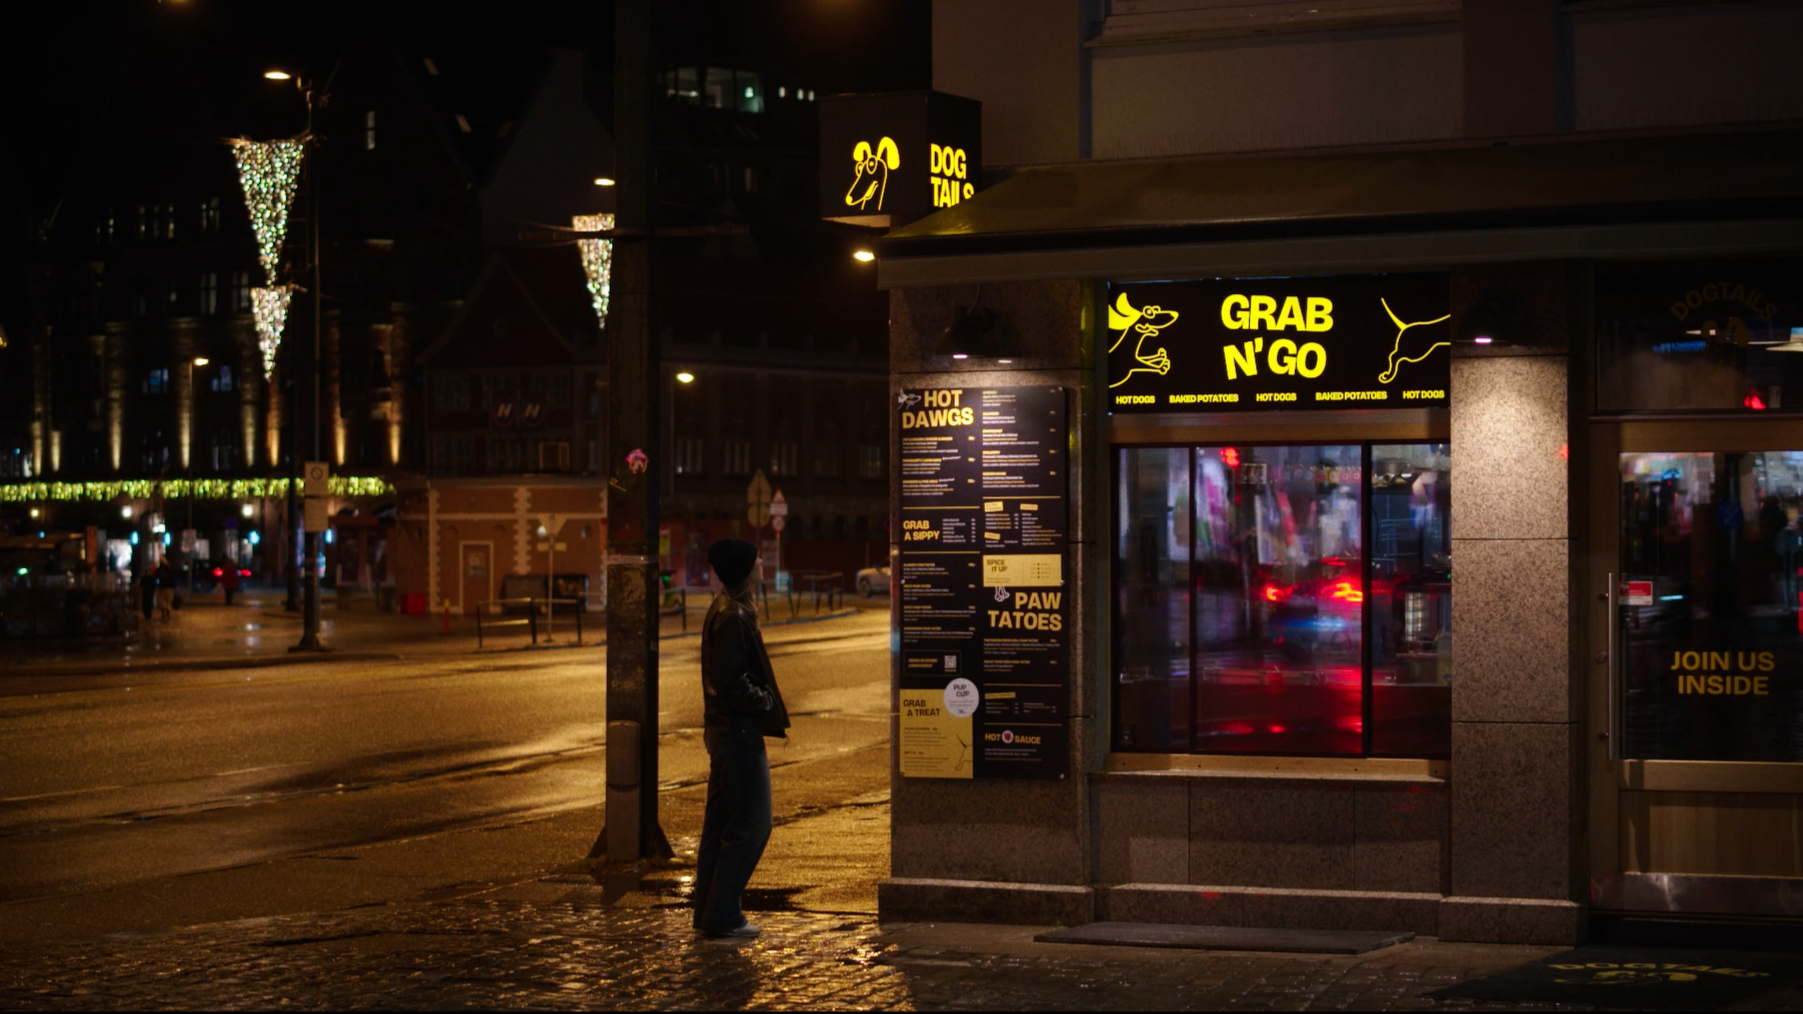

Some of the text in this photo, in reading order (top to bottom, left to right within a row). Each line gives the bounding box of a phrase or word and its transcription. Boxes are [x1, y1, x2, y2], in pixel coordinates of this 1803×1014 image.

[930, 143, 967, 180] DOG
[1669, 281, 1778, 322] DOGTAILS
[1221, 293, 1333, 332] GRAB
[924, 389, 963, 408] HOT
[1116, 394, 1156, 404] HOT DOGS
[1169, 394, 1239, 403] BAKED POTATOES
[1256, 393, 1298, 402] HOT DOGS
[1315, 391, 1388, 401] BAKED POTATOES
[1403, 390, 1445, 400] HOT DOGS
[902, 407, 975, 429] DAWGS
[903, 519, 930, 530] GRAB
[904, 531, 912, 541] A
[913, 530, 940, 541] SIPPY
[986, 558, 1005, 566] SPICE
[1014, 592, 1062, 610] PAW
[987, 609, 1063, 632] TATOES
[1670, 651, 1775, 671] JOIN US
[1678, 675, 1769, 695] INSIDE
[903, 699, 926, 707] GRAB
[906, 708, 940, 717] A TREAT
[984, 732, 1042, 745] HOT SAUCE
